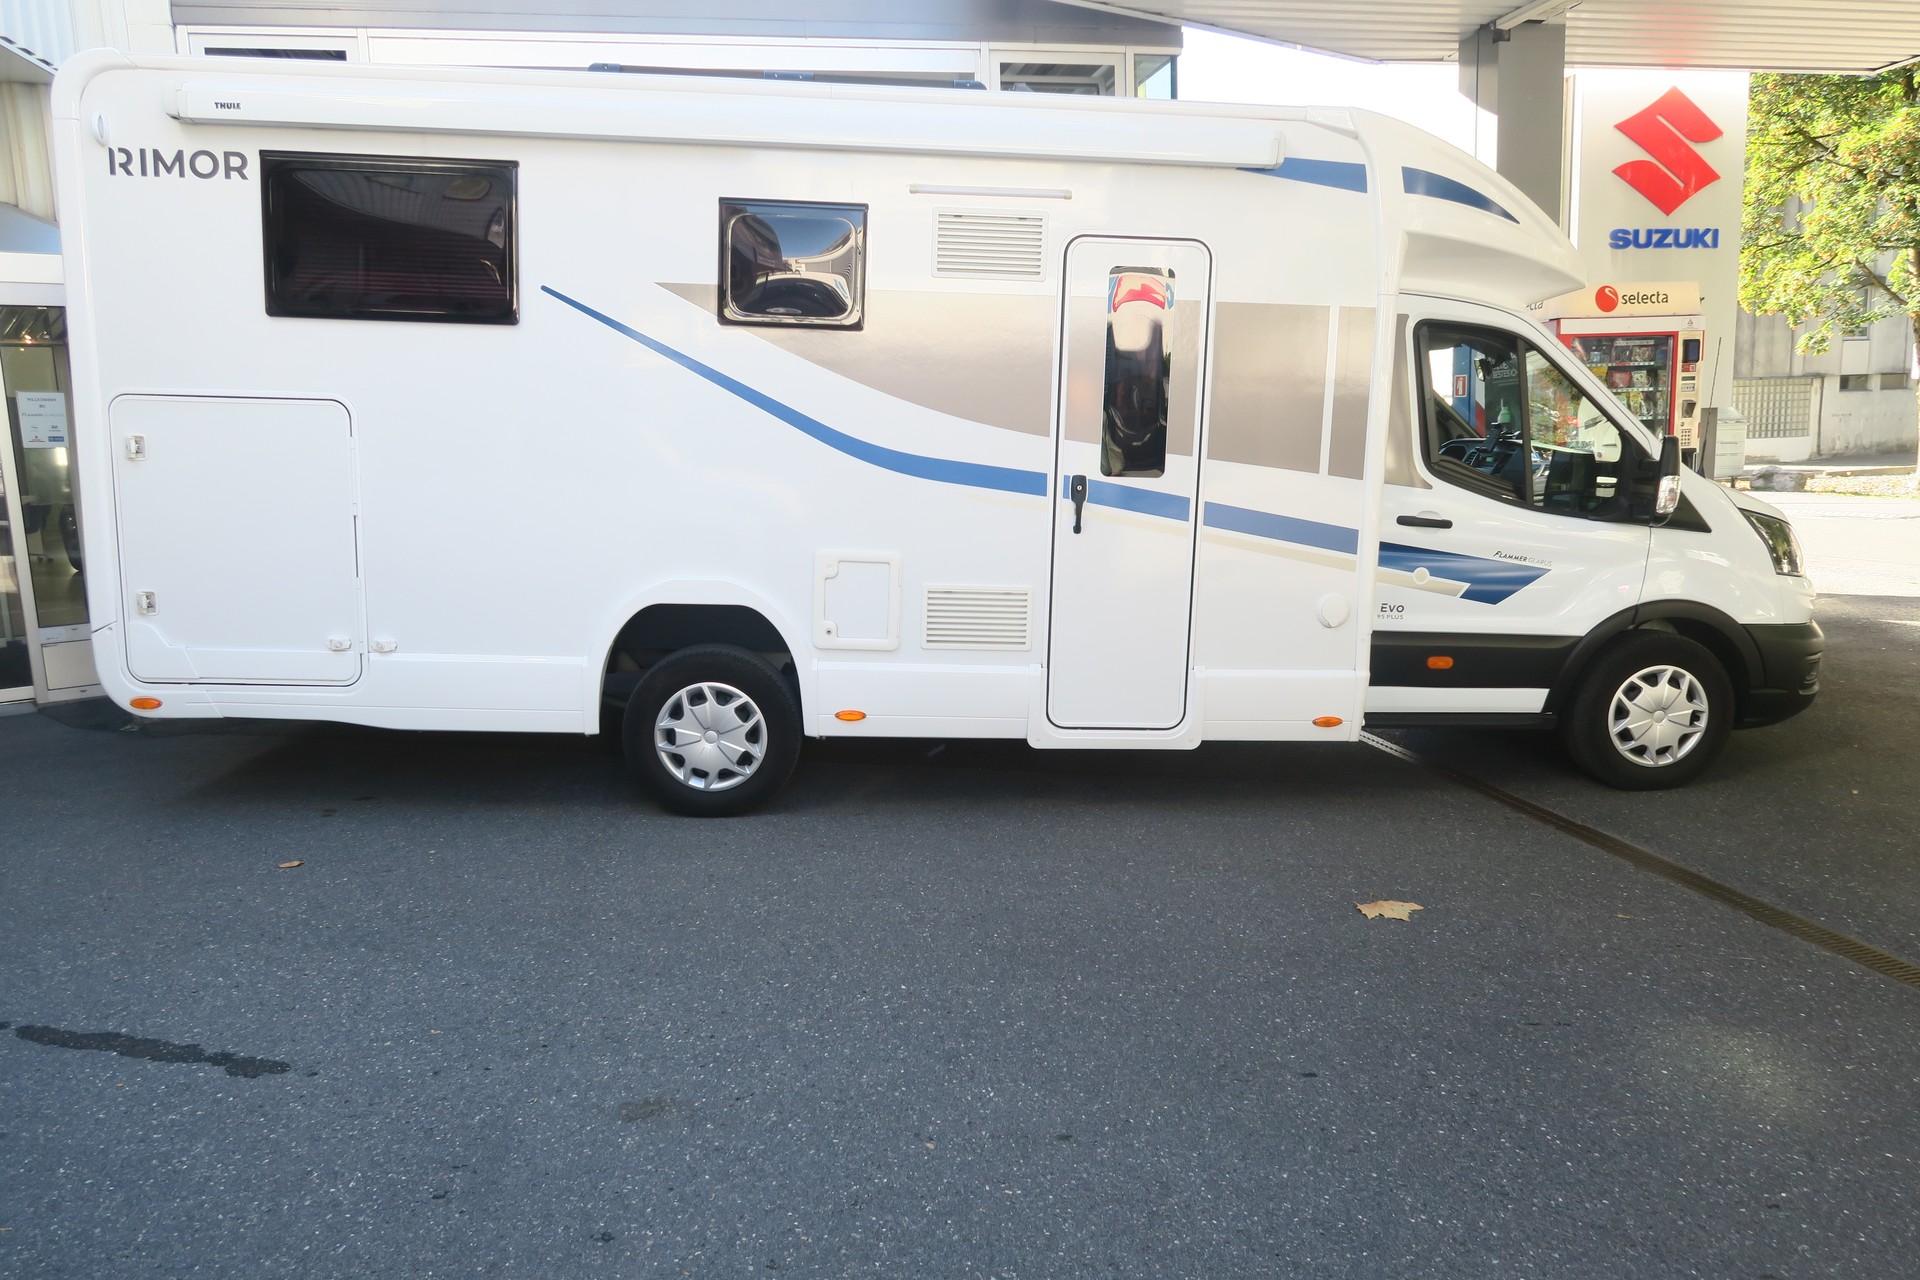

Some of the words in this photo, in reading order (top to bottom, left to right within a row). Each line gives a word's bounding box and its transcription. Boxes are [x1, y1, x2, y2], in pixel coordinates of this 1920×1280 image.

[214, 101, 242, 110] THULE
[108, 146, 249, 181] RIMOR
[1608, 228, 1720, 250] SUZUKI
[1621, 291, 1669, 305] selecta
